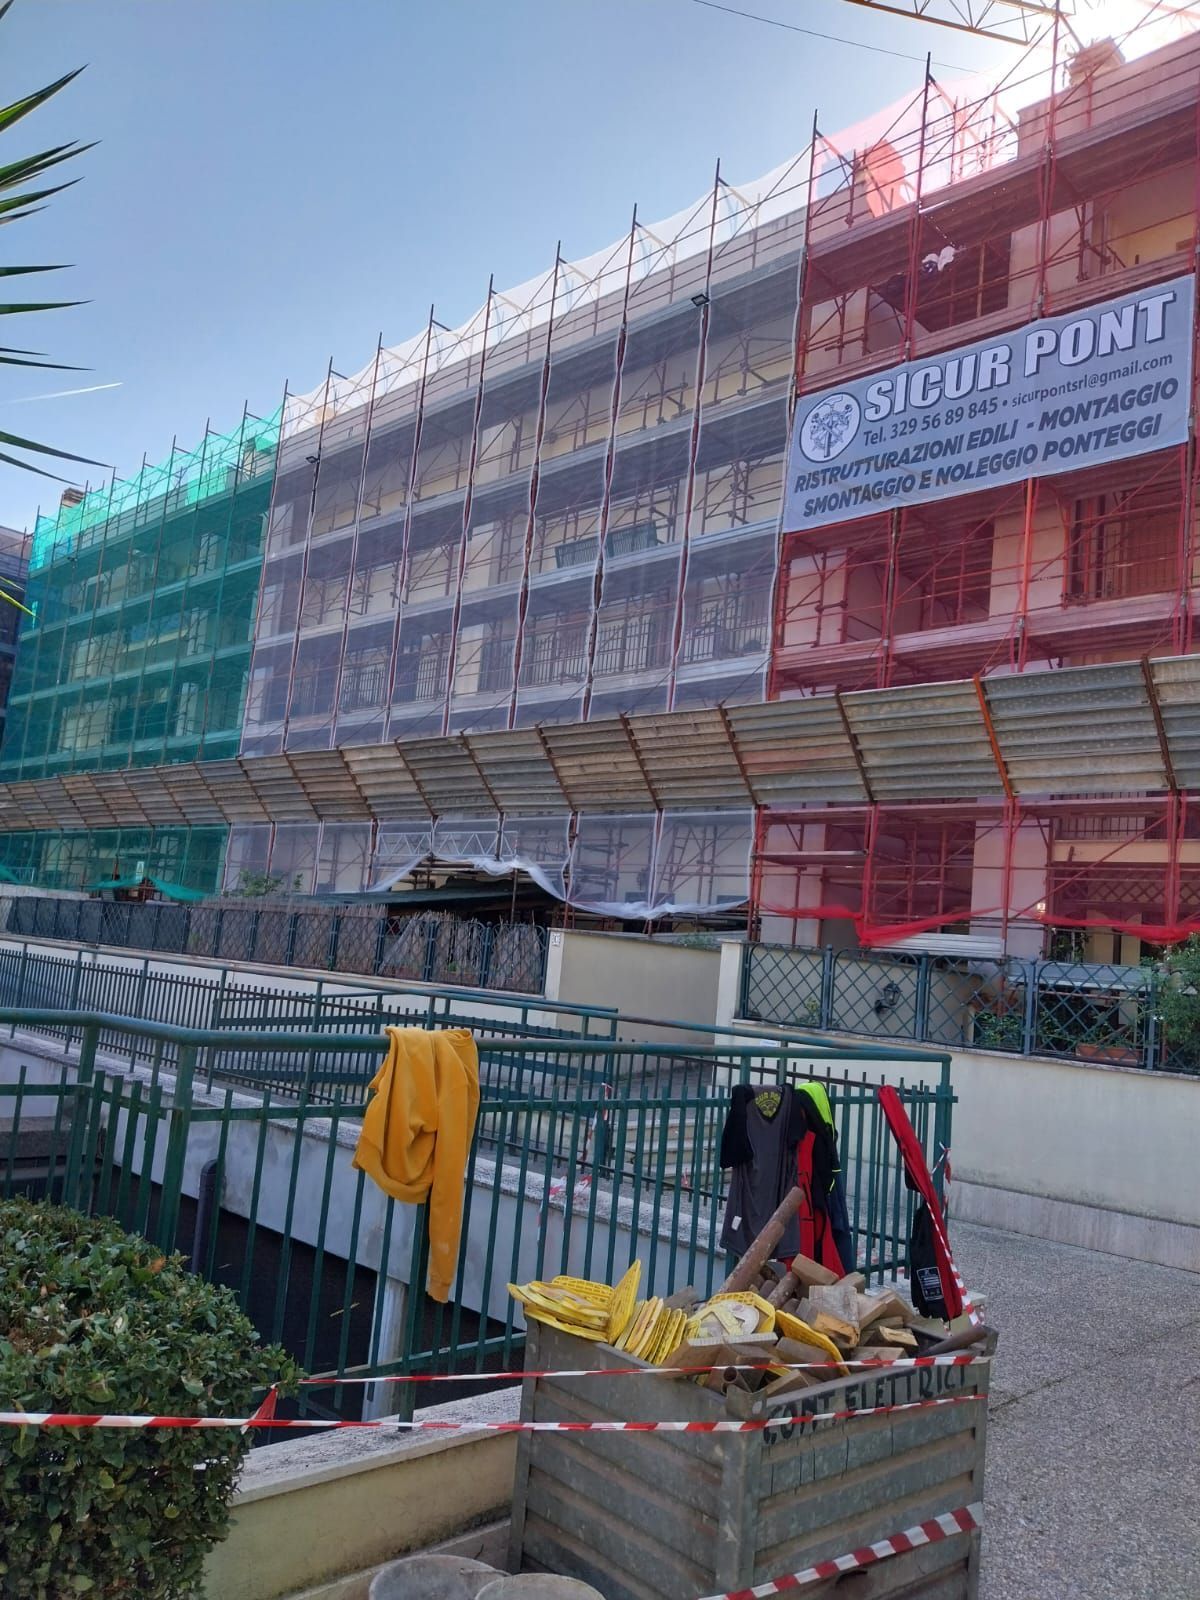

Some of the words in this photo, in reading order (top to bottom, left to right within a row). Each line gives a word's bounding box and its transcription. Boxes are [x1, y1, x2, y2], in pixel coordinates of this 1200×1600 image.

[864, 345, 1011, 421] SICUR
[1024, 292, 1176, 377] PONT
[864, 428, 887, 446] Tel.
[890, 419, 918, 439] 329
[921, 413, 942, 432] 56
[944, 406, 965, 425] 89
[968, 398, 998, 419] 845
[1012, 355, 1173, 407] sicurpontsrl@gmail.com
[794, 434, 964, 493] RISTRUTTURAZIONI
[966, 419, 1018, 450] EDILI
[1038, 377, 1179, 431] MONTAGGIO
[803, 475, 915, 517] SMONTAGGIO
[918, 469, 933, 490] E
[936, 443, 1038, 487] NOLEGGIO
[1042, 413, 1162, 462] PONTEGGI
[844, 1364, 966, 1418] ELETTRICI
